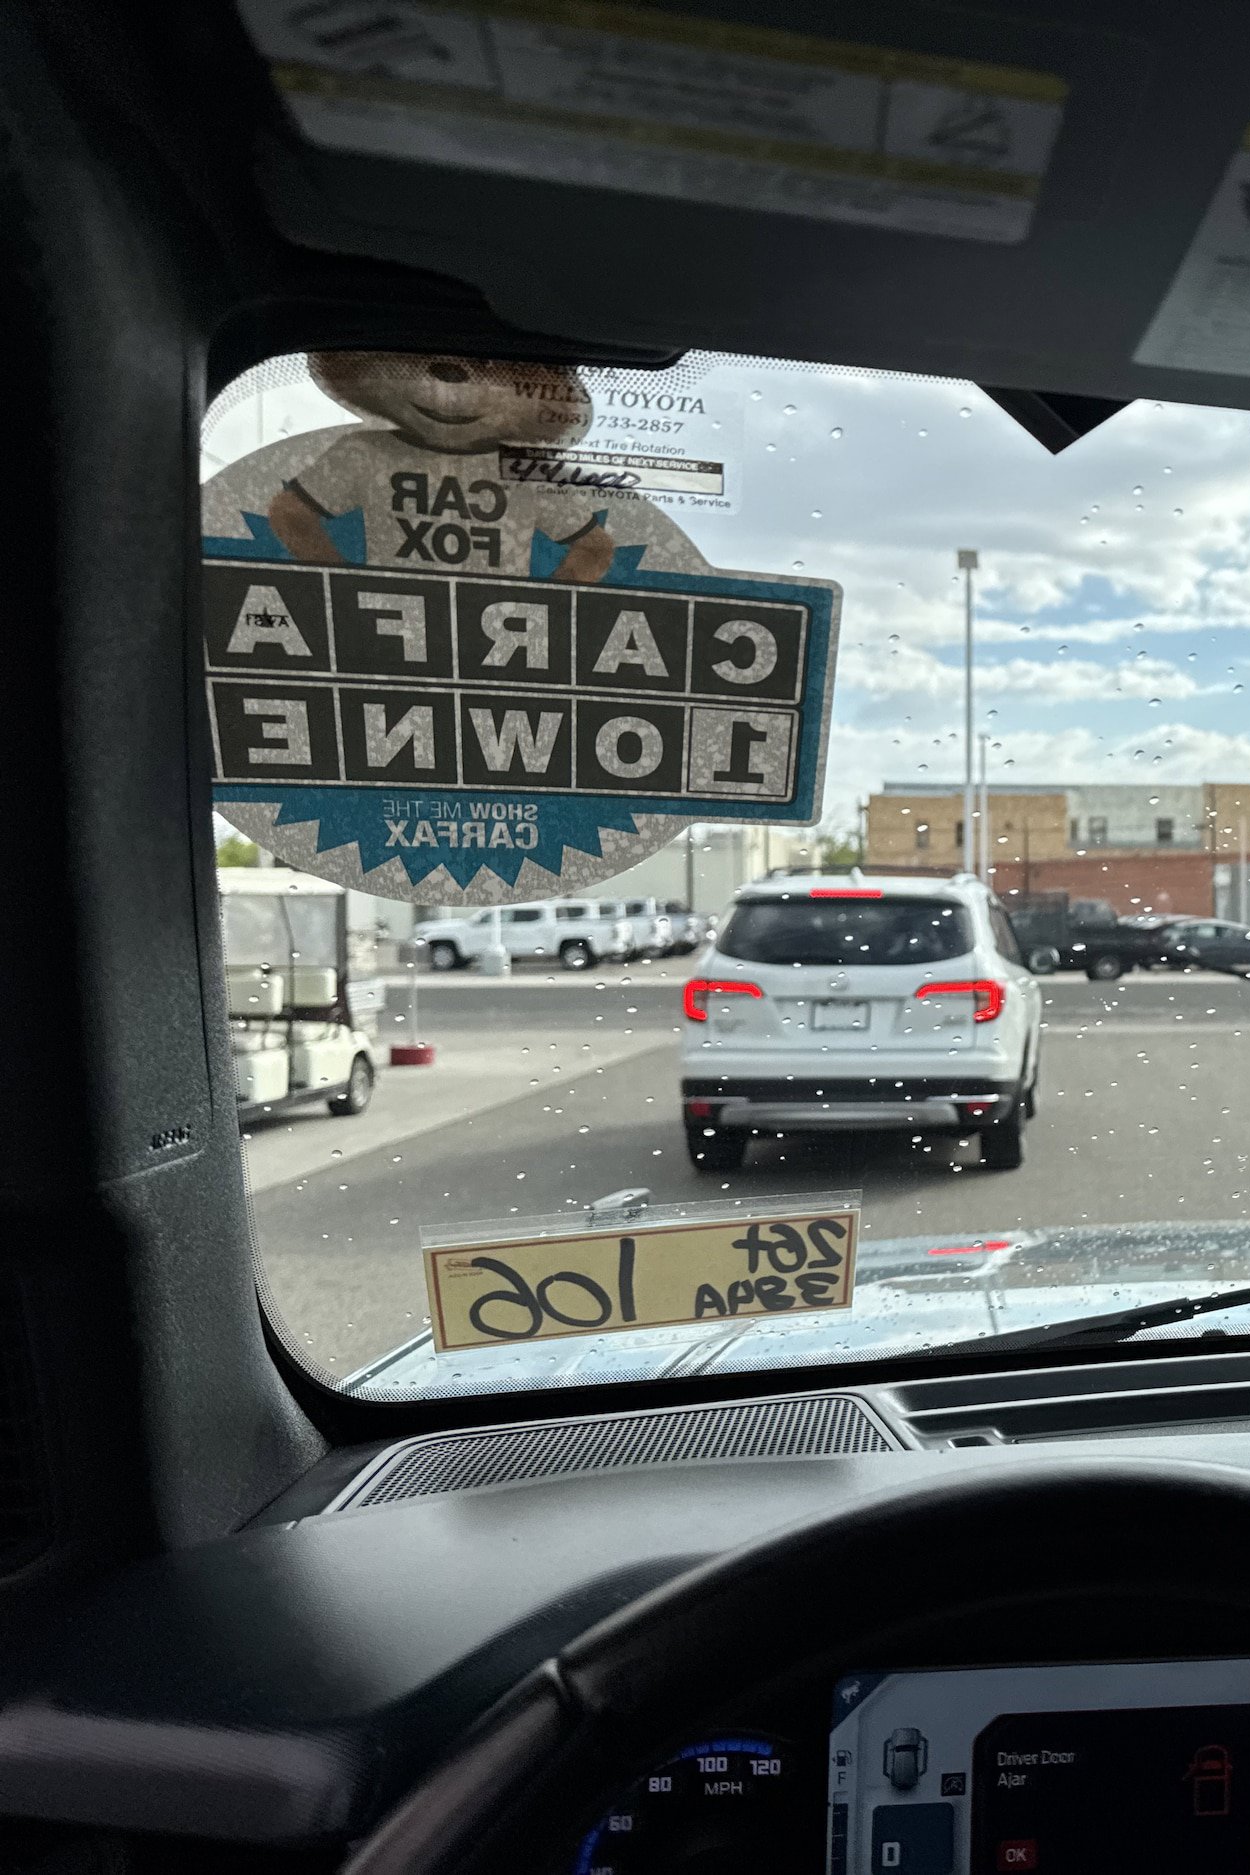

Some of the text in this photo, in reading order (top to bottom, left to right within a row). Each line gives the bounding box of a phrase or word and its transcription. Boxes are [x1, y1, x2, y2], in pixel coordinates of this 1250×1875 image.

[604, 388, 707, 415] TOYOTA
[596, 414, 684, 435] 733-2857
[604, 437, 629, 451] Tire
[631, 441, 686, 457] Rotation
[554, 452, 578, 462] AND
[578, 454, 609, 464] MILES
[628, 458, 655, 468] NEXT
[654, 459, 699, 471] SERVICE
[589, 488, 639, 501] TOYOTA
[696, 1756, 729, 1774] 100
[996, 1749, 1075, 1767] Driver Door
[749, 1758, 782, 1777] 120
[647, 1776, 673, 1793] 80
[703, 1780, 744, 1797] MPH
[996, 1771, 1027, 1789] Ajar
[607, 1815, 633, 1832] 60
[1004, 1848, 1028, 1863] OK
